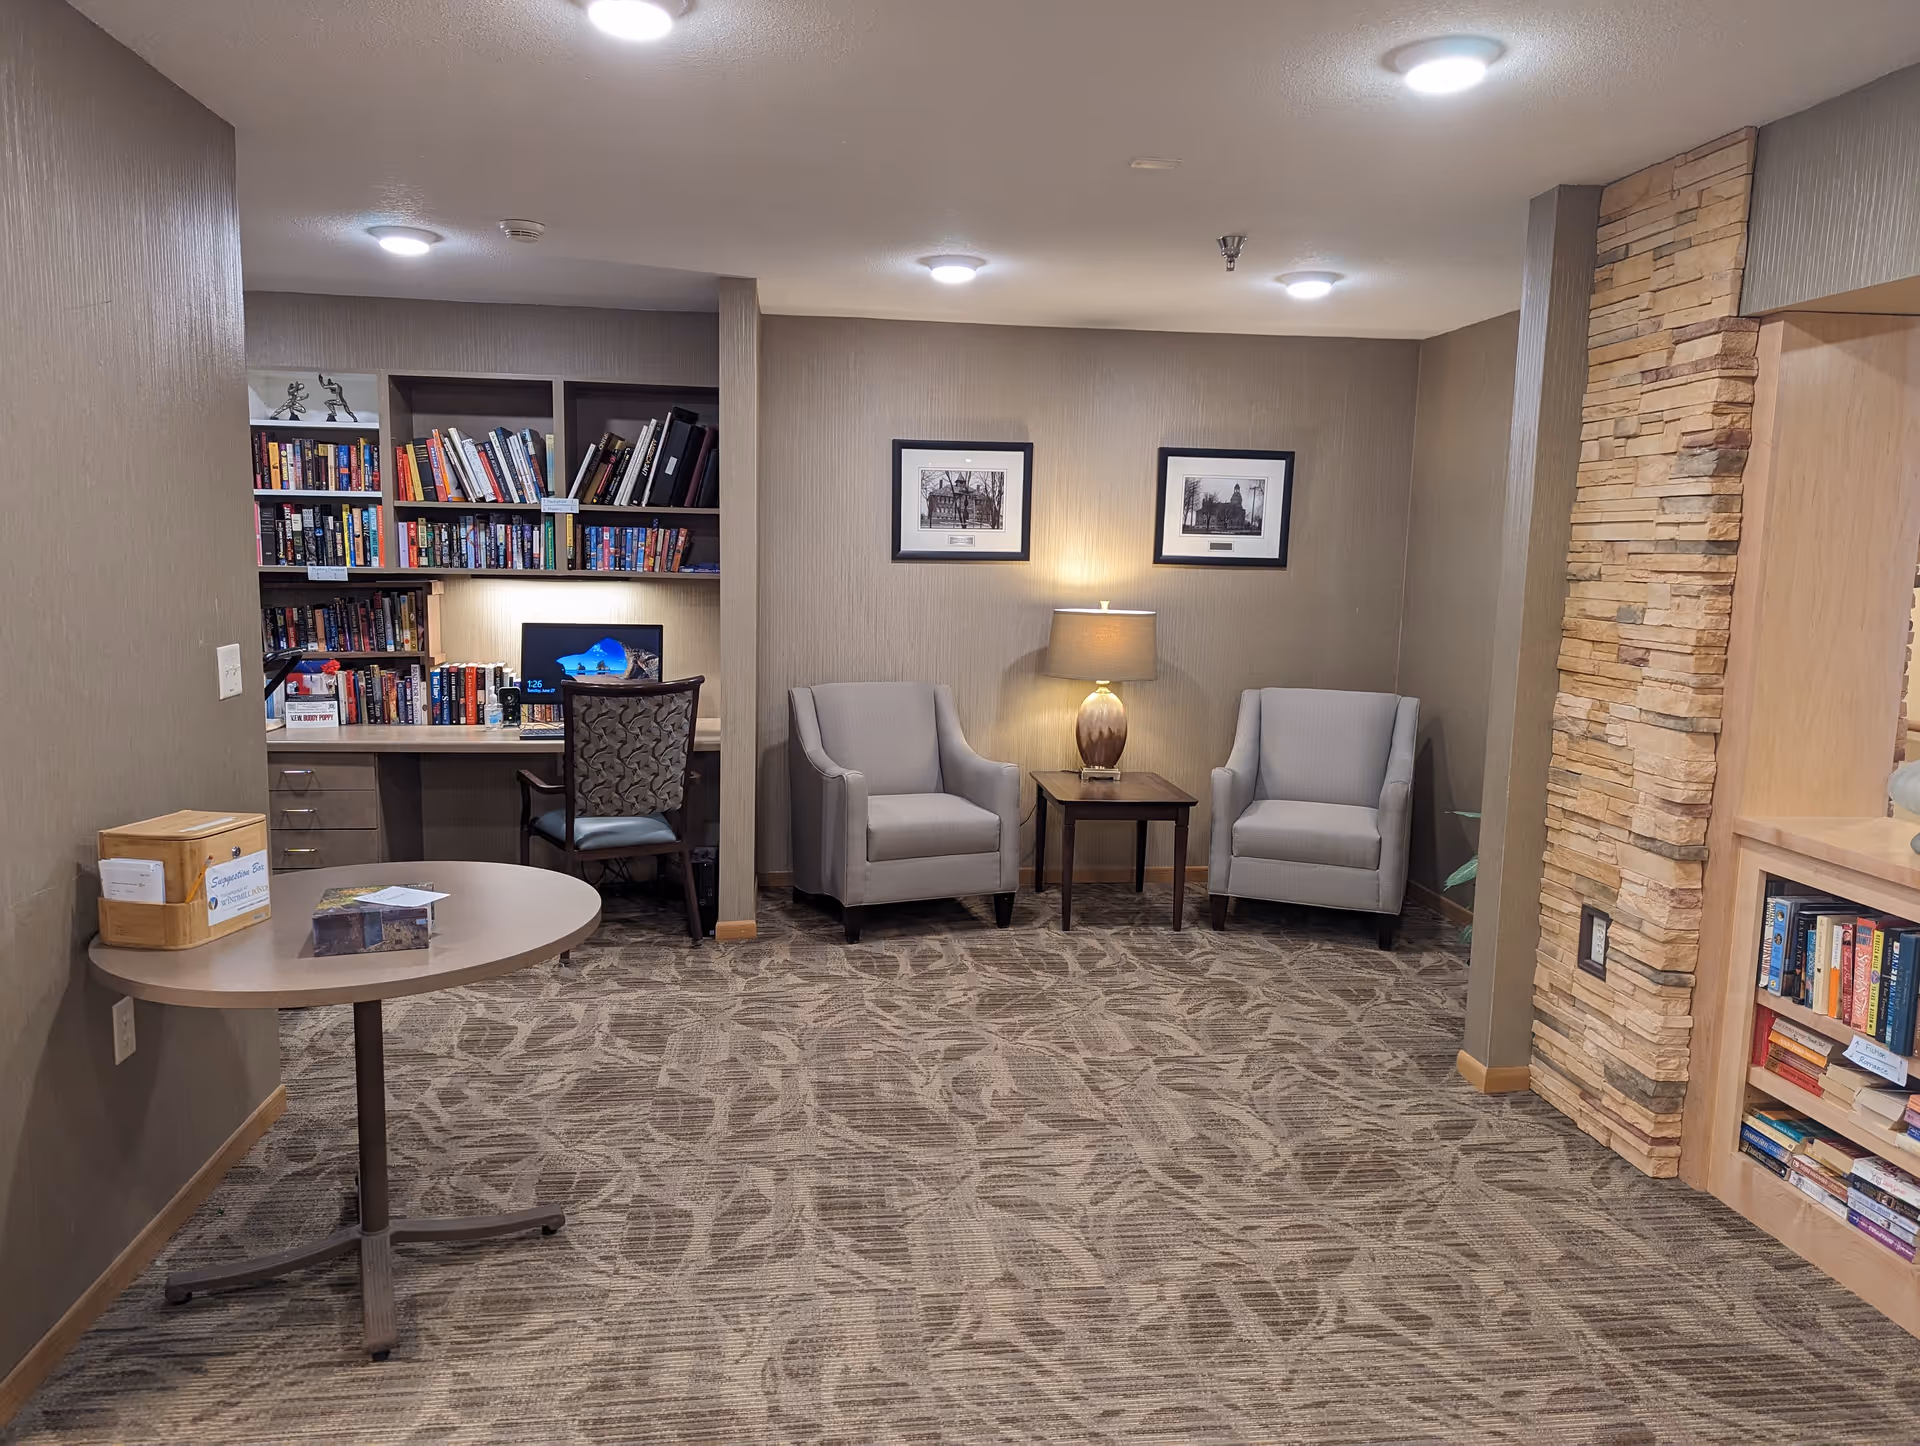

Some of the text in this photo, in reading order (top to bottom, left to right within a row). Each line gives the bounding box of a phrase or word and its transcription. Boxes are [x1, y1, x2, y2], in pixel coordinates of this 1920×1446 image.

[432, 685, 440, 698] Clancy
[527, 680, 542, 688] 1:26
[211, 862, 264, 888] Suggestion Box
[221, 890, 251, 906] WINDMILL
[1854, 948, 1870, 993] Scruples
[1854, 995, 1866, 1018] Two
[1865, 1044, 1886, 1059] Fiction
[1858, 1056, 1889, 1075] Romance
